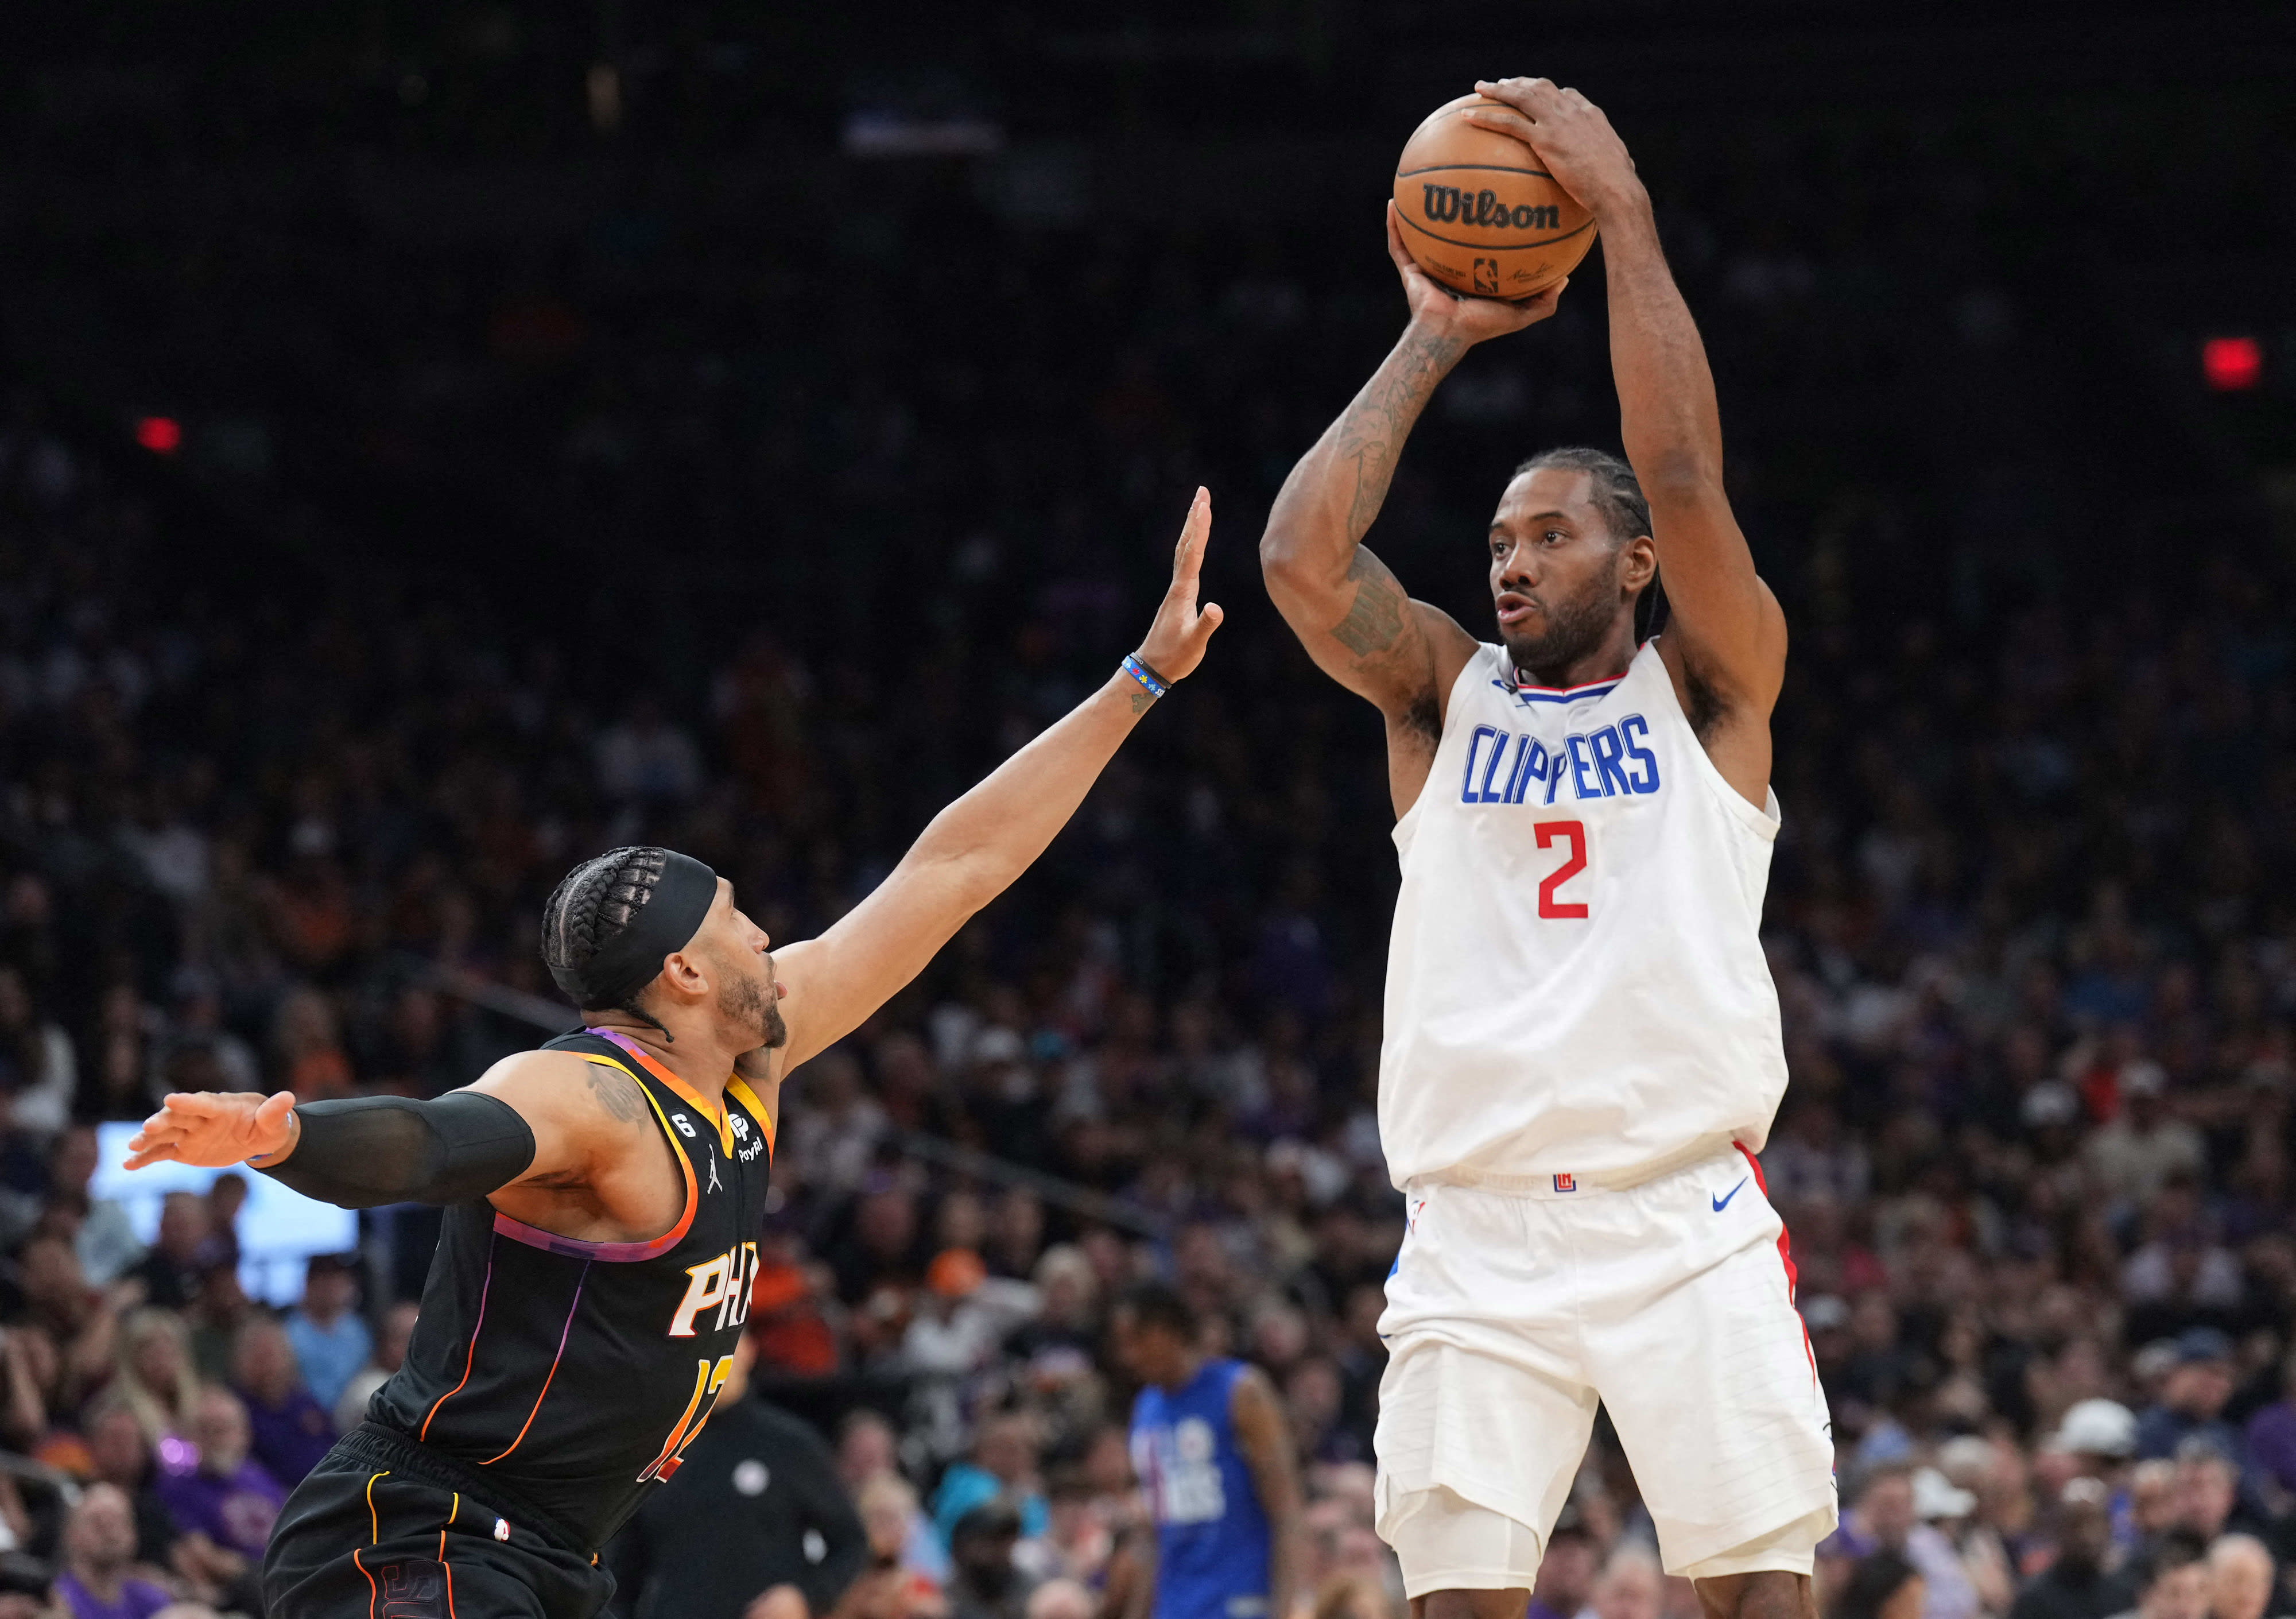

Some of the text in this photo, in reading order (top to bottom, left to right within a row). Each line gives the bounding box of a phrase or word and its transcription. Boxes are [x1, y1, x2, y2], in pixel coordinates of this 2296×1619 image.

[1424, 183, 1561, 229] Wilson
[1461, 713, 1660, 805] CLIPPERS
[1533, 820, 1588, 919] 2
[672, 1113, 696, 1138] 6
